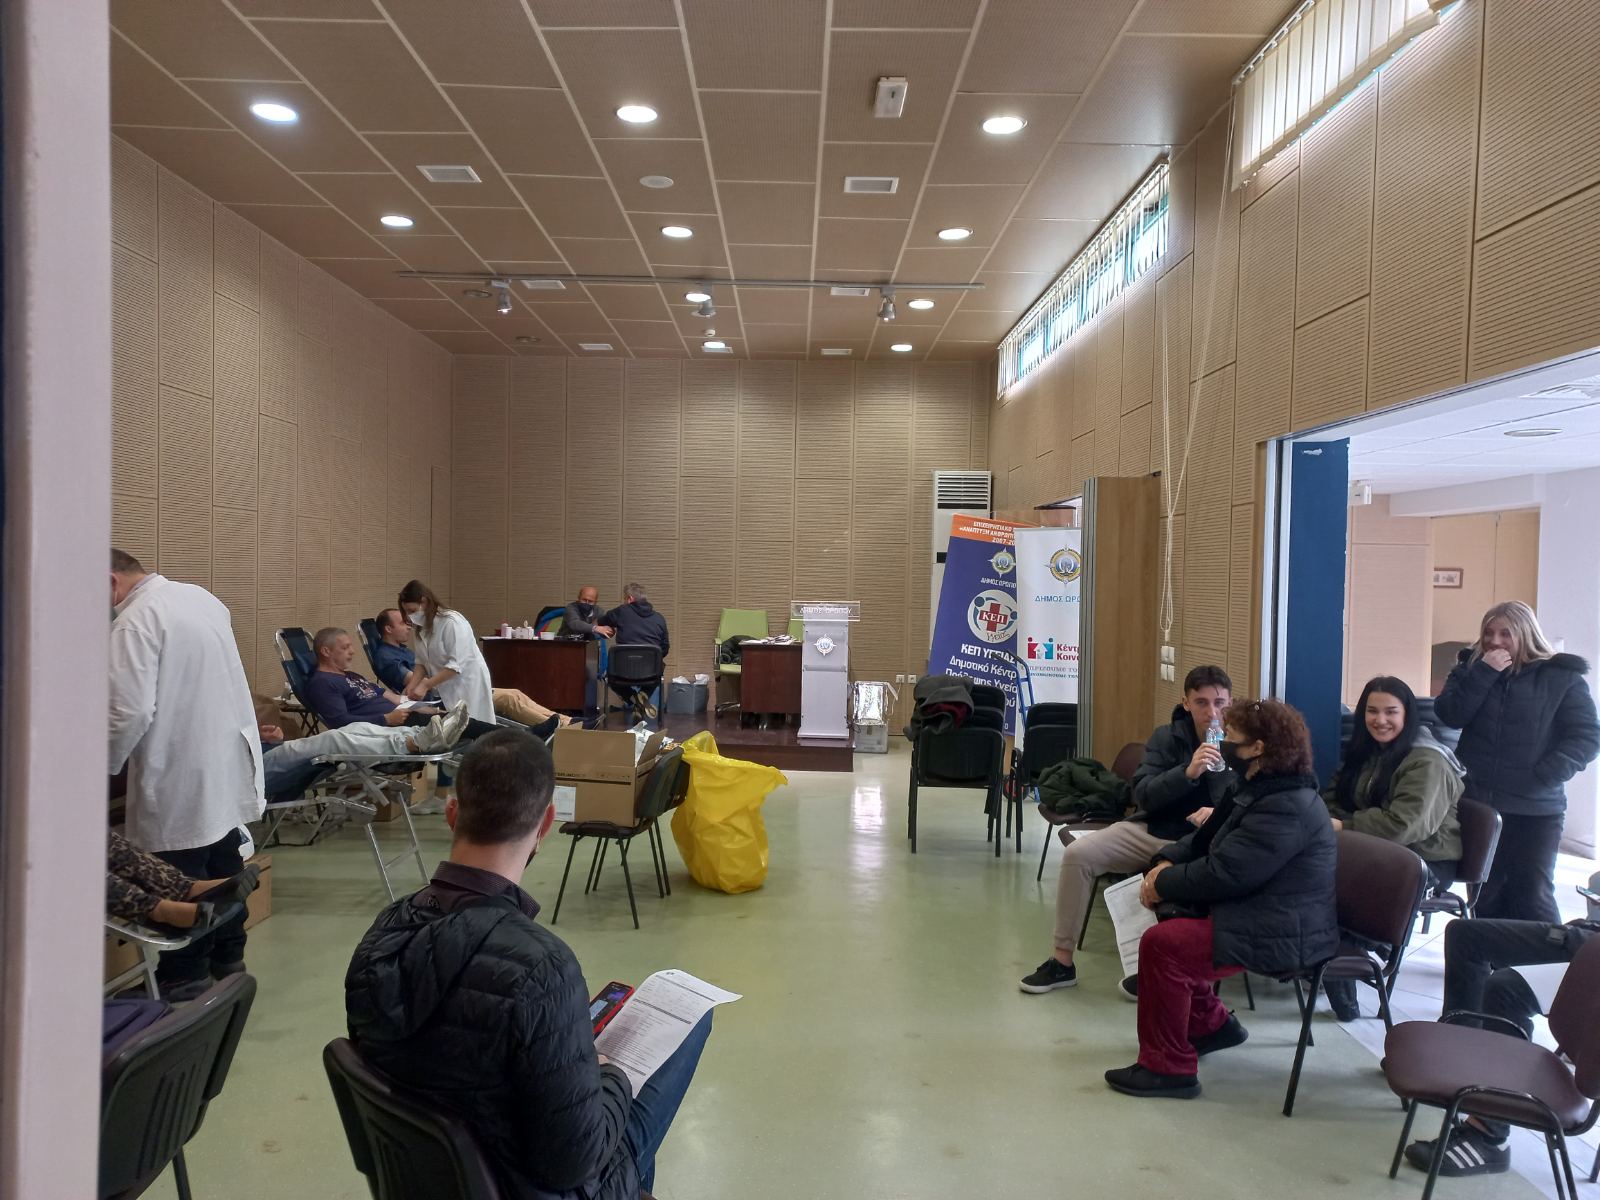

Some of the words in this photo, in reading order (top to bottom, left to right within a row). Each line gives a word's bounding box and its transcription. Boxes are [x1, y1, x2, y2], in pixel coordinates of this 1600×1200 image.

[982, 611, 1005, 624] ΚΕΠ
[960, 643, 982, 657] ΚΕΠ
[949, 656, 989, 673] Δημοτικό
[990, 664, 1017, 681] Κέντρ
